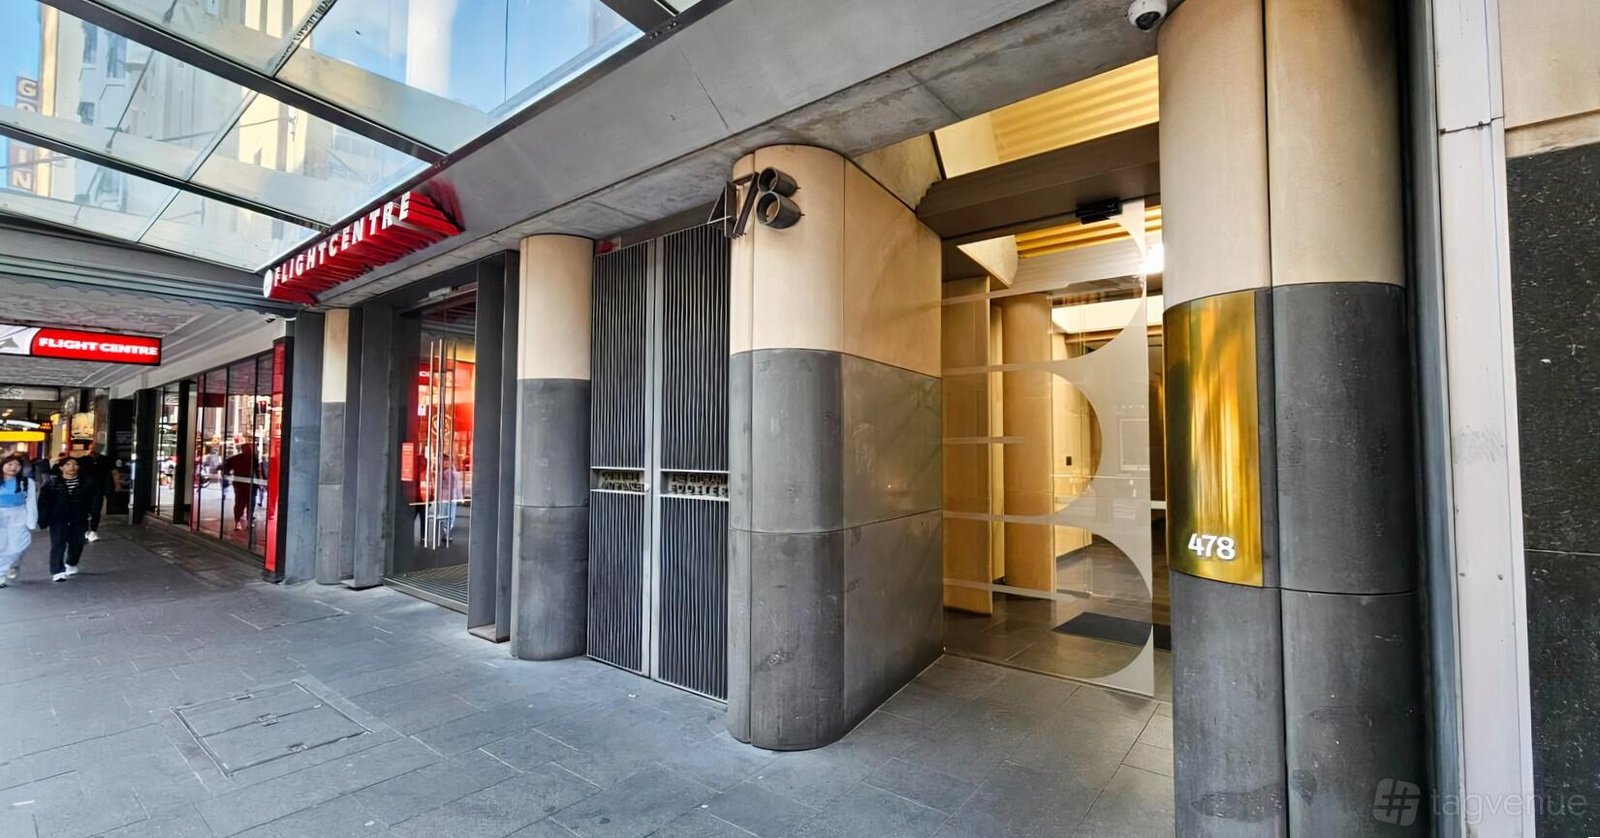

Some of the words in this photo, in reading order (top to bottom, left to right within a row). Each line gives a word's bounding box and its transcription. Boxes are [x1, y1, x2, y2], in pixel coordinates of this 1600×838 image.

[39, 337, 99, 351] FLIGHT
[99, 343, 158, 356] CENTRE
[1187, 533, 1236, 560] 478
